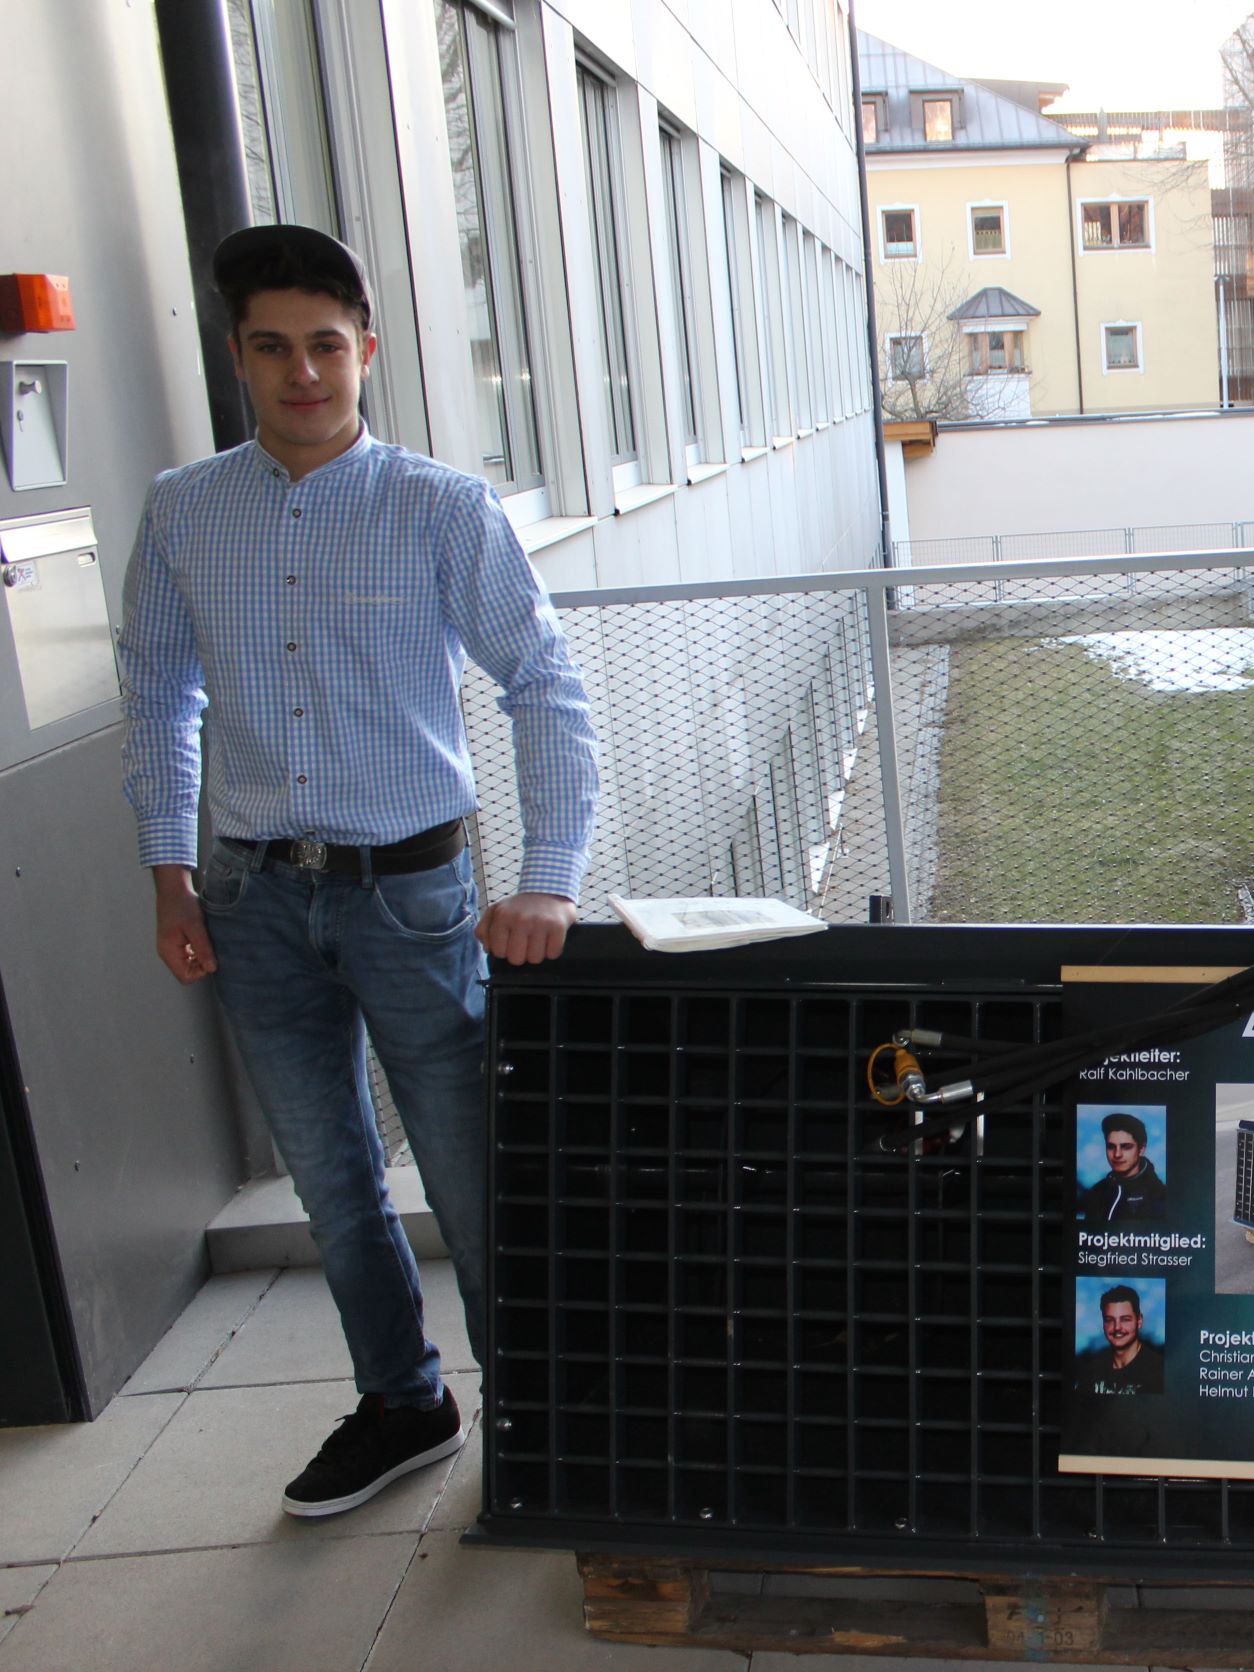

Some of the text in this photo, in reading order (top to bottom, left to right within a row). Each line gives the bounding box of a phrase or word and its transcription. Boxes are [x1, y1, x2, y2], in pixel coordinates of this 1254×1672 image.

[1079, 1067, 1190, 1081] Ralf Kahlbacher
[1078, 1232, 1206, 1250] Projektmitglied:
[1078, 1251, 1193, 1267] Siegfried Strasser
[1199, 1367, 1244, 1380] Rainer
[1199, 1385, 1249, 1398] Helmut
